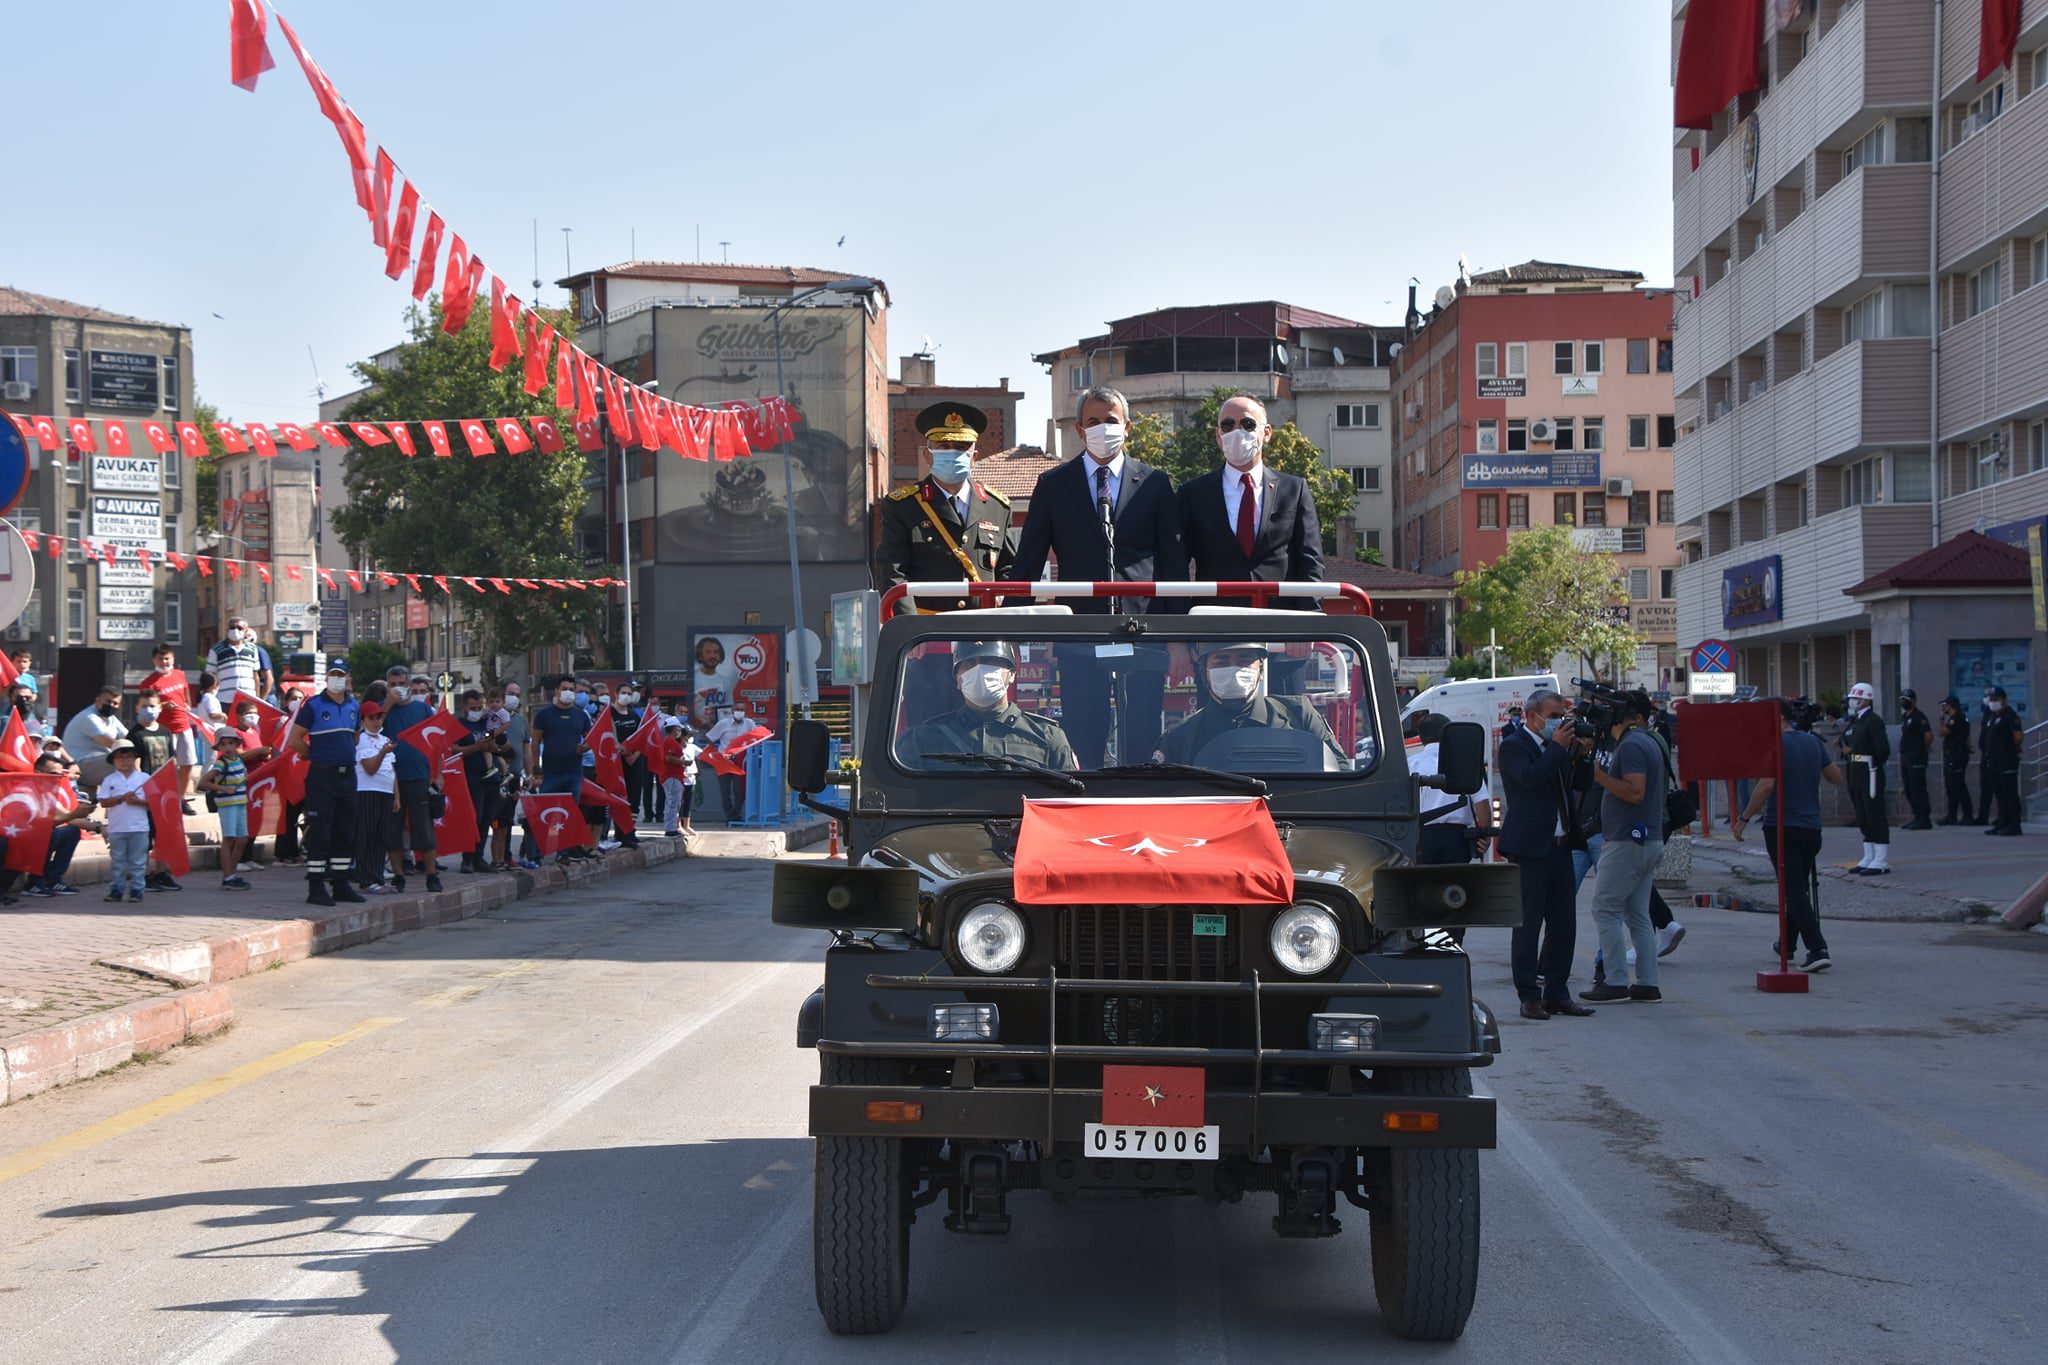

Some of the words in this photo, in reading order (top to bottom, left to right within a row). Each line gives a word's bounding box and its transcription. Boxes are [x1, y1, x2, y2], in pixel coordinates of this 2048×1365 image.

[697, 323, 812, 351] Gülbaba
[96, 459, 158, 473] AVUKAT
[106, 499, 160, 515] AVUKAT
[109, 539, 148, 548] AVUKAT
[275, 604, 306, 614] pozitif
[107, 620, 148, 628] AVUKAT
[1094, 1129, 1207, 1154] 057006
